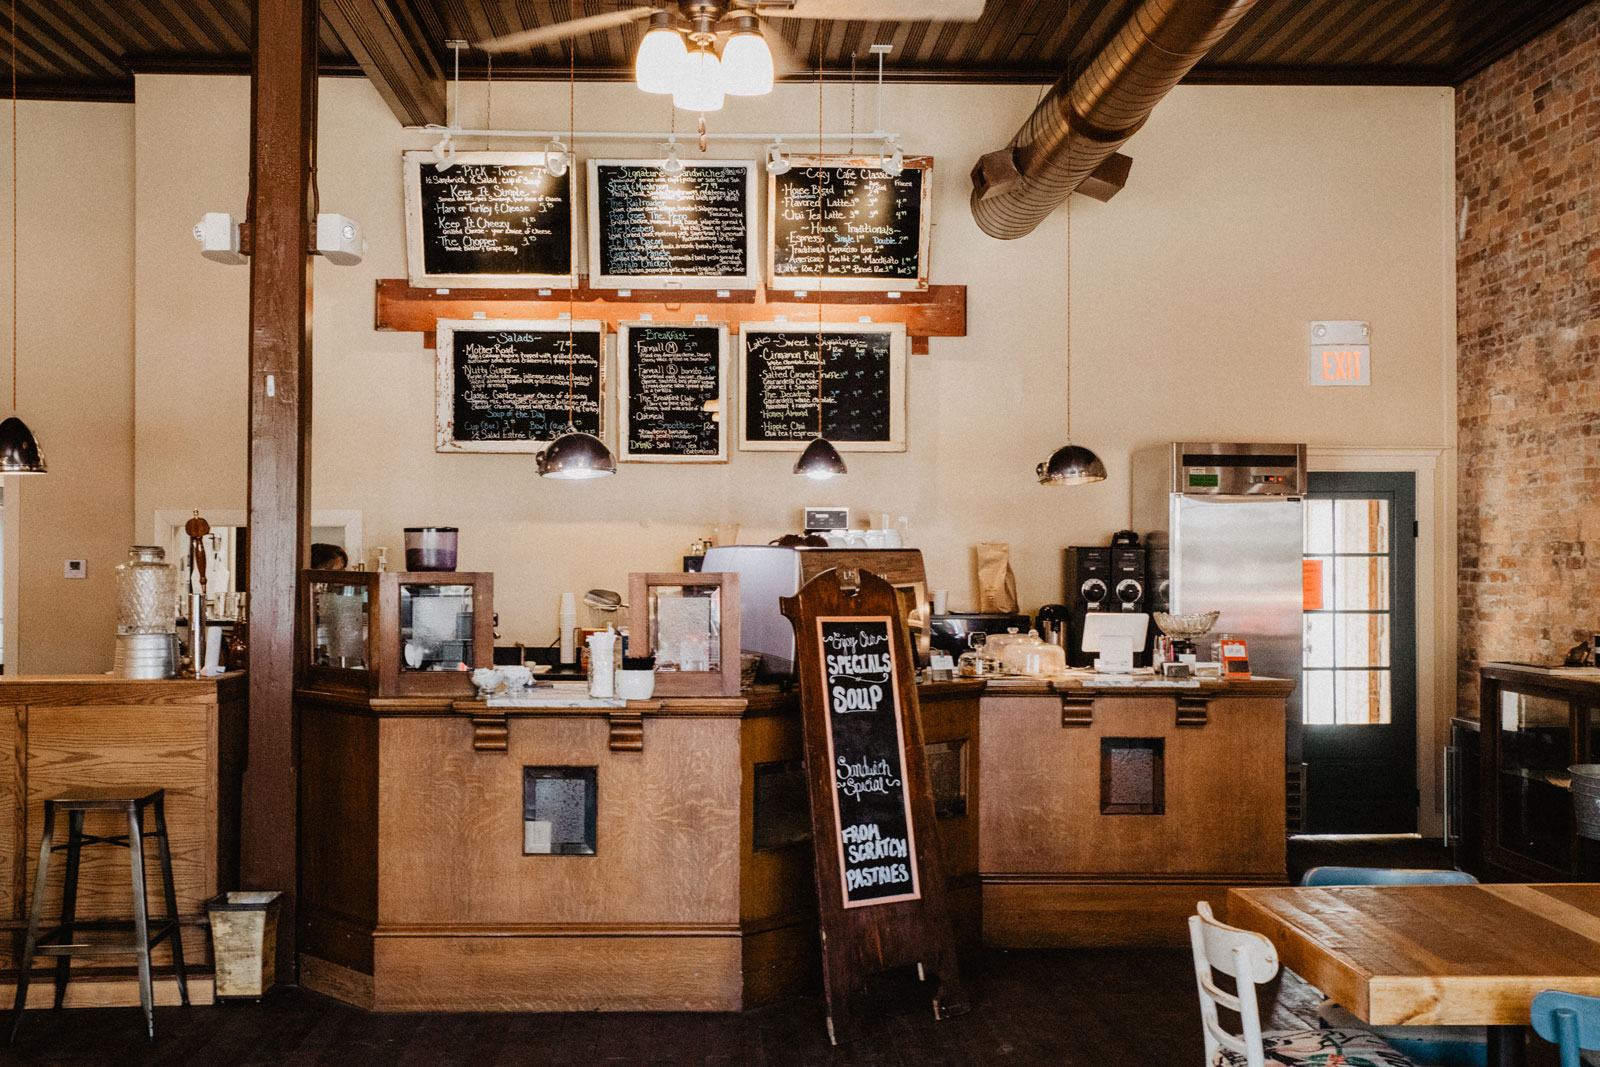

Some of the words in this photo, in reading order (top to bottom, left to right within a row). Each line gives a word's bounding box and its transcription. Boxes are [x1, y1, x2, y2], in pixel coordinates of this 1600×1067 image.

[618, 166, 666, 179] Signature
[681, 168, 725, 178] andwiches
[806, 168, 830, 184] Cozy
[836, 168, 857, 180] Café
[450, 184, 473, 197] Keep
[477, 186, 490, 197] It
[494, 185, 530, 197] Simple
[607, 182, 630, 192] Steak
[784, 184, 810, 196] House
[607, 197, 623, 208] The
[784, 196, 821, 208] Flavored
[827, 198, 851, 208] Latte
[437, 203, 456, 214] Ham
[466, 202, 492, 216] Turkey
[501, 203, 530, 213] Cheese
[784, 209, 804, 220] Chai
[808, 209, 821, 220] Tea
[824, 209, 846, 220] Latte
[438, 216, 460, 228] Keep
[463, 216, 476, 228] It
[477, 217, 510, 230] Cheezy
[608, 224, 623, 233] The
[625, 223, 654, 233] Reuben
[812, 222, 838, 234] House
[844, 222, 893, 235] Traditionals
[437, 236, 459, 246] The
[463, 236, 497, 248] Chopper
[789, 231, 825, 247] Espresso
[834, 234, 855, 247] Single
[872, 236, 897, 244] Double
[788, 243, 826, 255] Traditional
[641, 260, 672, 268] Chicken
[789, 255, 825, 263] Americano
[497, 332, 534, 344] Salads
[644, 329, 688, 340] Breakfast
[776, 333, 810, 347] Sweet
[815, 334, 858, 351] Signatures
[465, 344, 496, 356] Mother
[495, 343, 514, 355] Road
[762, 348, 801, 360] Cinnamon
[804, 350, 819, 360] Roll
[464, 364, 488, 377] Nutty
[1322, 351, 1362, 380] EXIT
[762, 370, 788, 380] Salted
[790, 370, 815, 379] Caramel
[464, 390, 490, 400] Classic
[492, 389, 516, 399] Garden
[636, 393, 651, 402] The
[762, 390, 777, 398] The
[486, 408, 505, 419] Soup
[515, 410, 529, 418] the
[530, 410, 546, 422] Day
[636, 411, 665, 420] Oatmeal
[762, 410, 784, 420] Honey
[785, 409, 808, 417] Almond
[530, 421, 547, 430] Bowl
[656, 420, 695, 430] Smoothies
[763, 422, 787, 431] Hippie
[481, 428, 500, 439] Salad
[630, 440, 652, 449] Drinks
[832, 630, 857, 657] Enjoy
[859, 630, 881, 648] Our
[827, 653, 892, 675] SPECIALS
[833, 684, 883, 713] SOUP
[837, 755, 893, 779] Sandwich
[845, 777, 888, 802] Special
[842, 824, 880, 844] FROM
[848, 838, 907, 864] SCRATCH
[846, 863, 910, 891] PASTRIES
